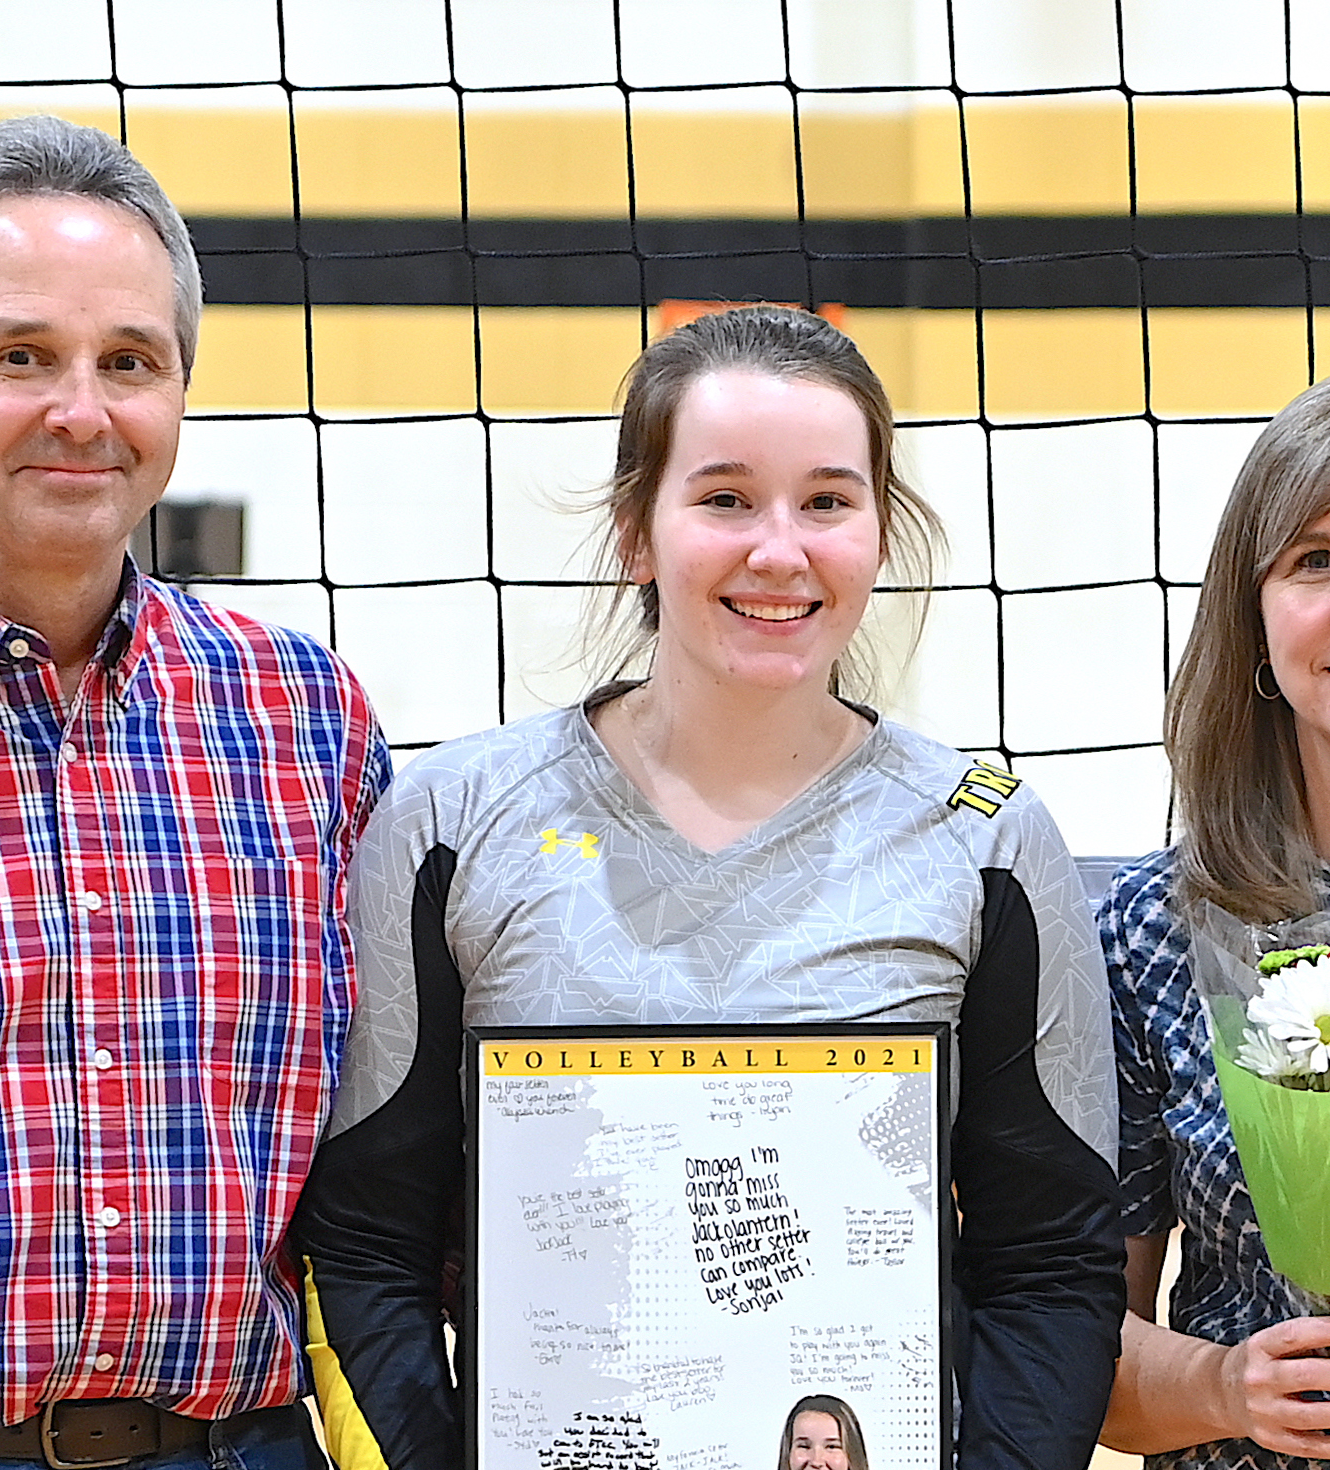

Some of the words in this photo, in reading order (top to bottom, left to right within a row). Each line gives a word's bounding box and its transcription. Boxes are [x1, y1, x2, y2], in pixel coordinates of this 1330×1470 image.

[946, 759, 1023, 819] TR
[492, 1049, 788, 1069] VOLLEYBALL
[826, 1048, 922, 1067] 2021
[751, 1146, 780, 1164] I'm
[685, 1180, 739, 1203] gonna
[746, 1172, 780, 1195] miss
[688, 1200, 719, 1222] you
[724, 1198, 742, 1214] so
[745, 1192, 789, 1211] much
[695, 1247, 715, 1263] no
[720, 1237, 763, 1259] other
[768, 1229, 811, 1251] setter
[700, 1266, 728, 1284] can
[744, 1275, 773, 1297] you
